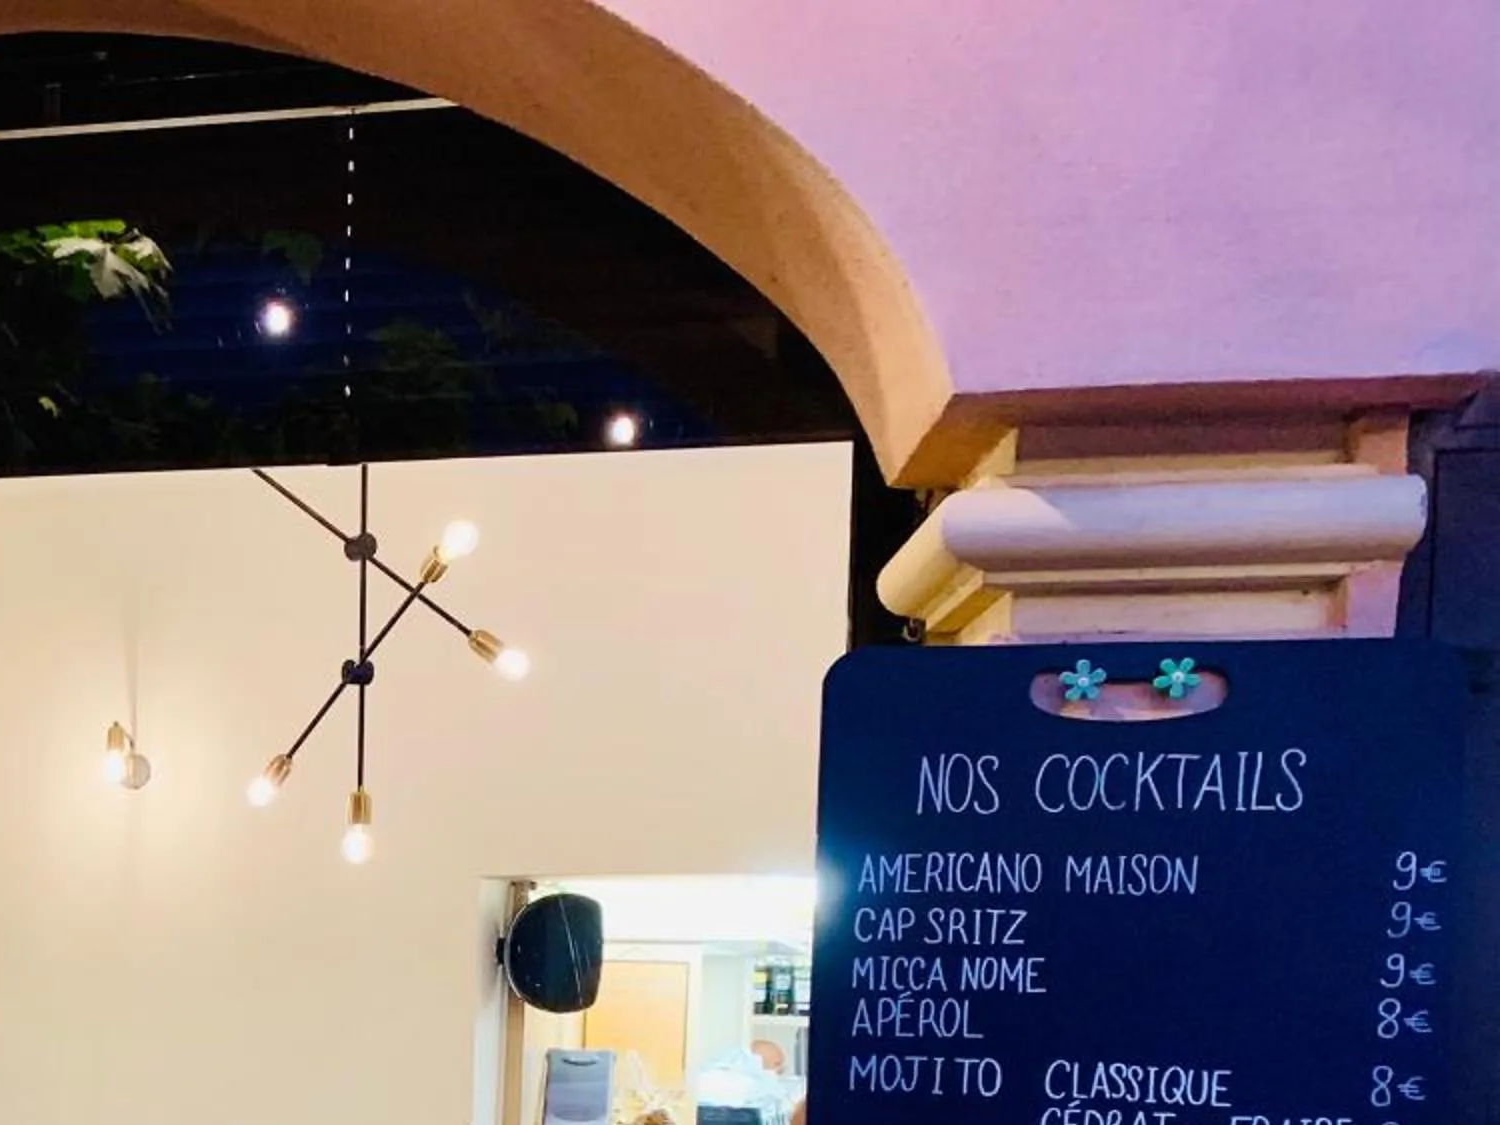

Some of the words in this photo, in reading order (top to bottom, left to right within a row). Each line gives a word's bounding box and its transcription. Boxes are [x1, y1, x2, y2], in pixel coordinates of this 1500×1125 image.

[916, 754, 1000, 815] NOS
[1035, 748, 1307, 812] COCKTAILS
[858, 852, 1042, 893] AMERICANO
[1066, 855, 1199, 895] MAISON
[854, 907, 915, 945] CAP
[925, 910, 1027, 945] SRITZ
[852, 956, 948, 993] MICCA
[961, 956, 1047, 994] NOME
[851, 993, 984, 1039] APÉROL
[849, 1055, 1002, 1097] MOJITO
[1045, 1059, 1232, 1107] CLASSIQUE
